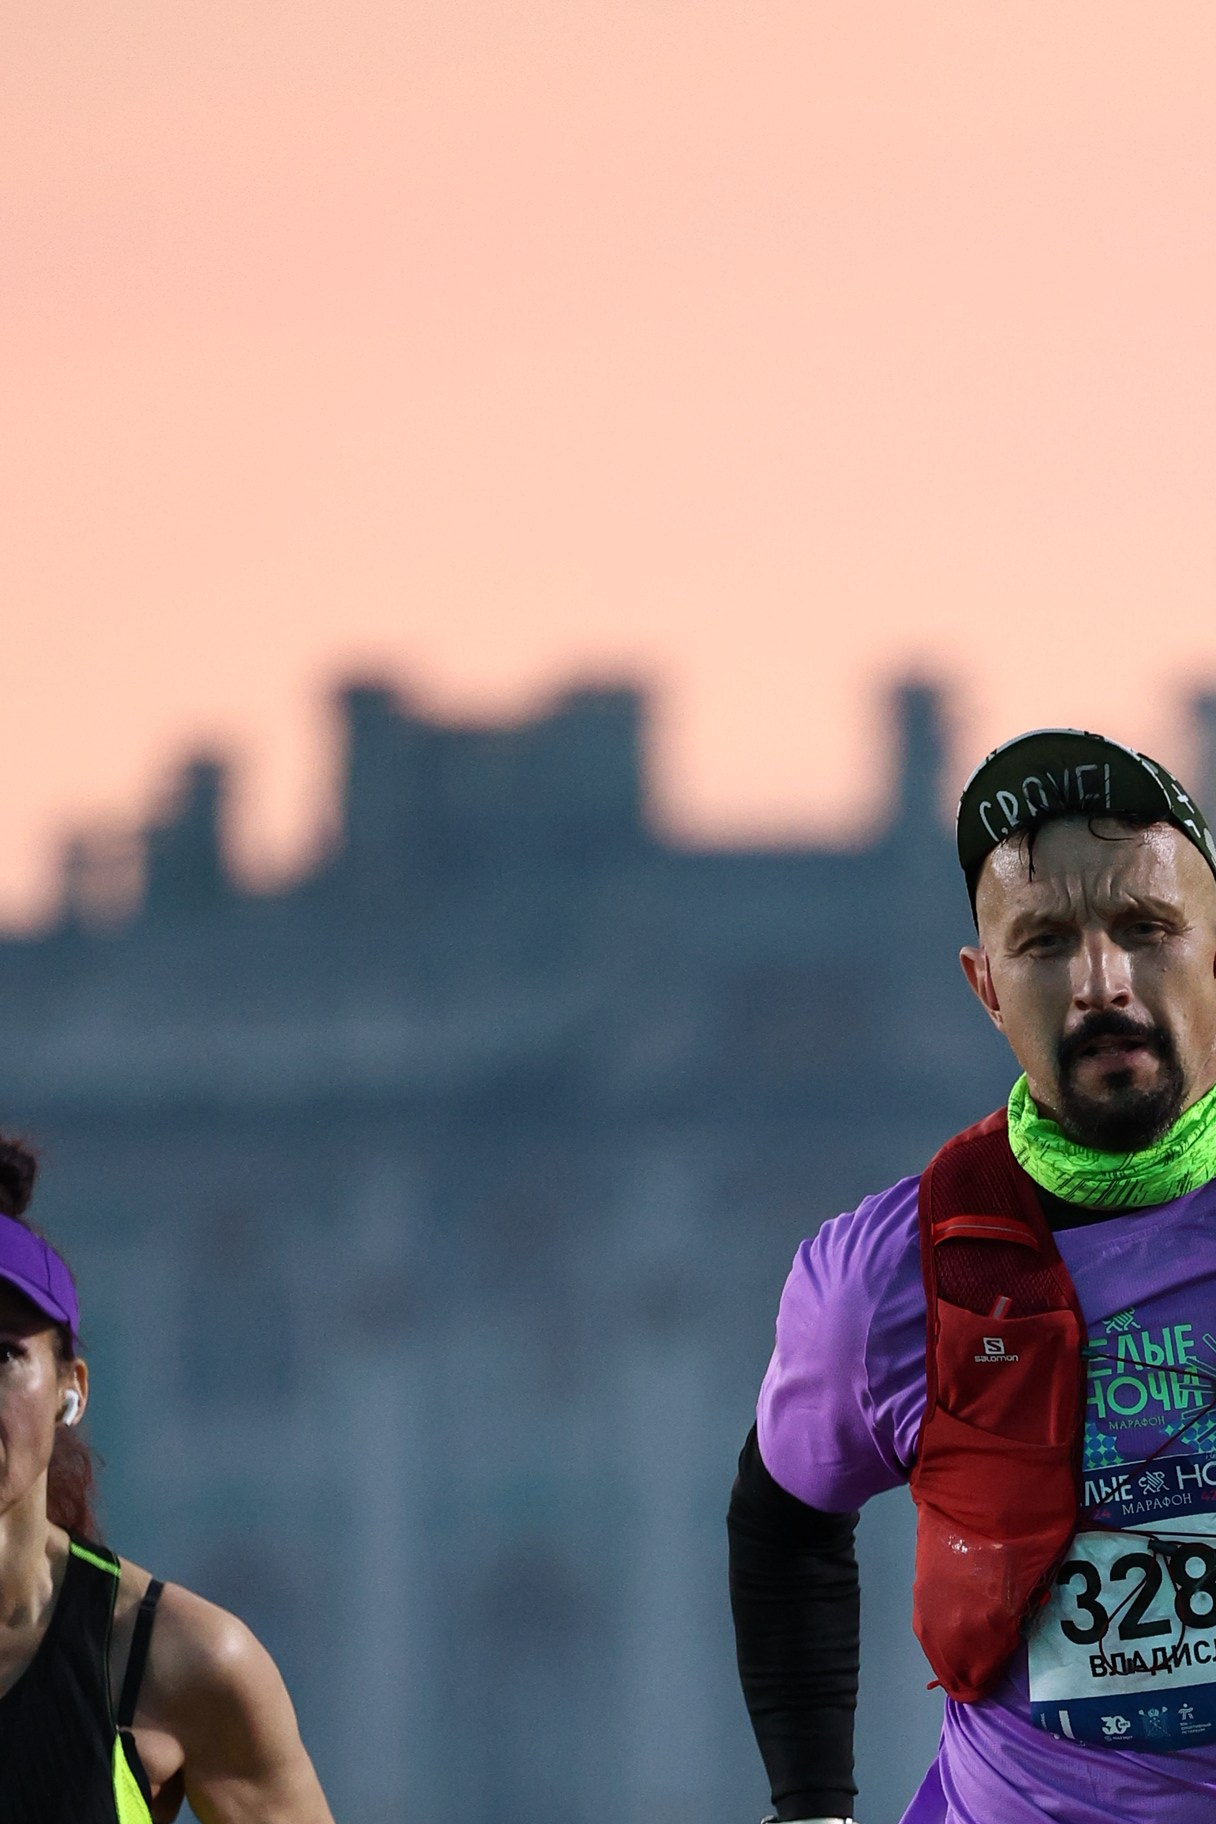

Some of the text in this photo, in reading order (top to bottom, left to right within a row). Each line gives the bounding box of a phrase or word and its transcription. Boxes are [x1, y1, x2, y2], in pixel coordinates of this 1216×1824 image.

[1086, 1324, 1195, 1378] ЕЛЫЕ
[1108, 1415, 1166, 1431] МАРАФОН
[1084, 1474, 1134, 1507] ЛЫЕ
[1121, 1492, 1193, 1516] МАРАФОН
